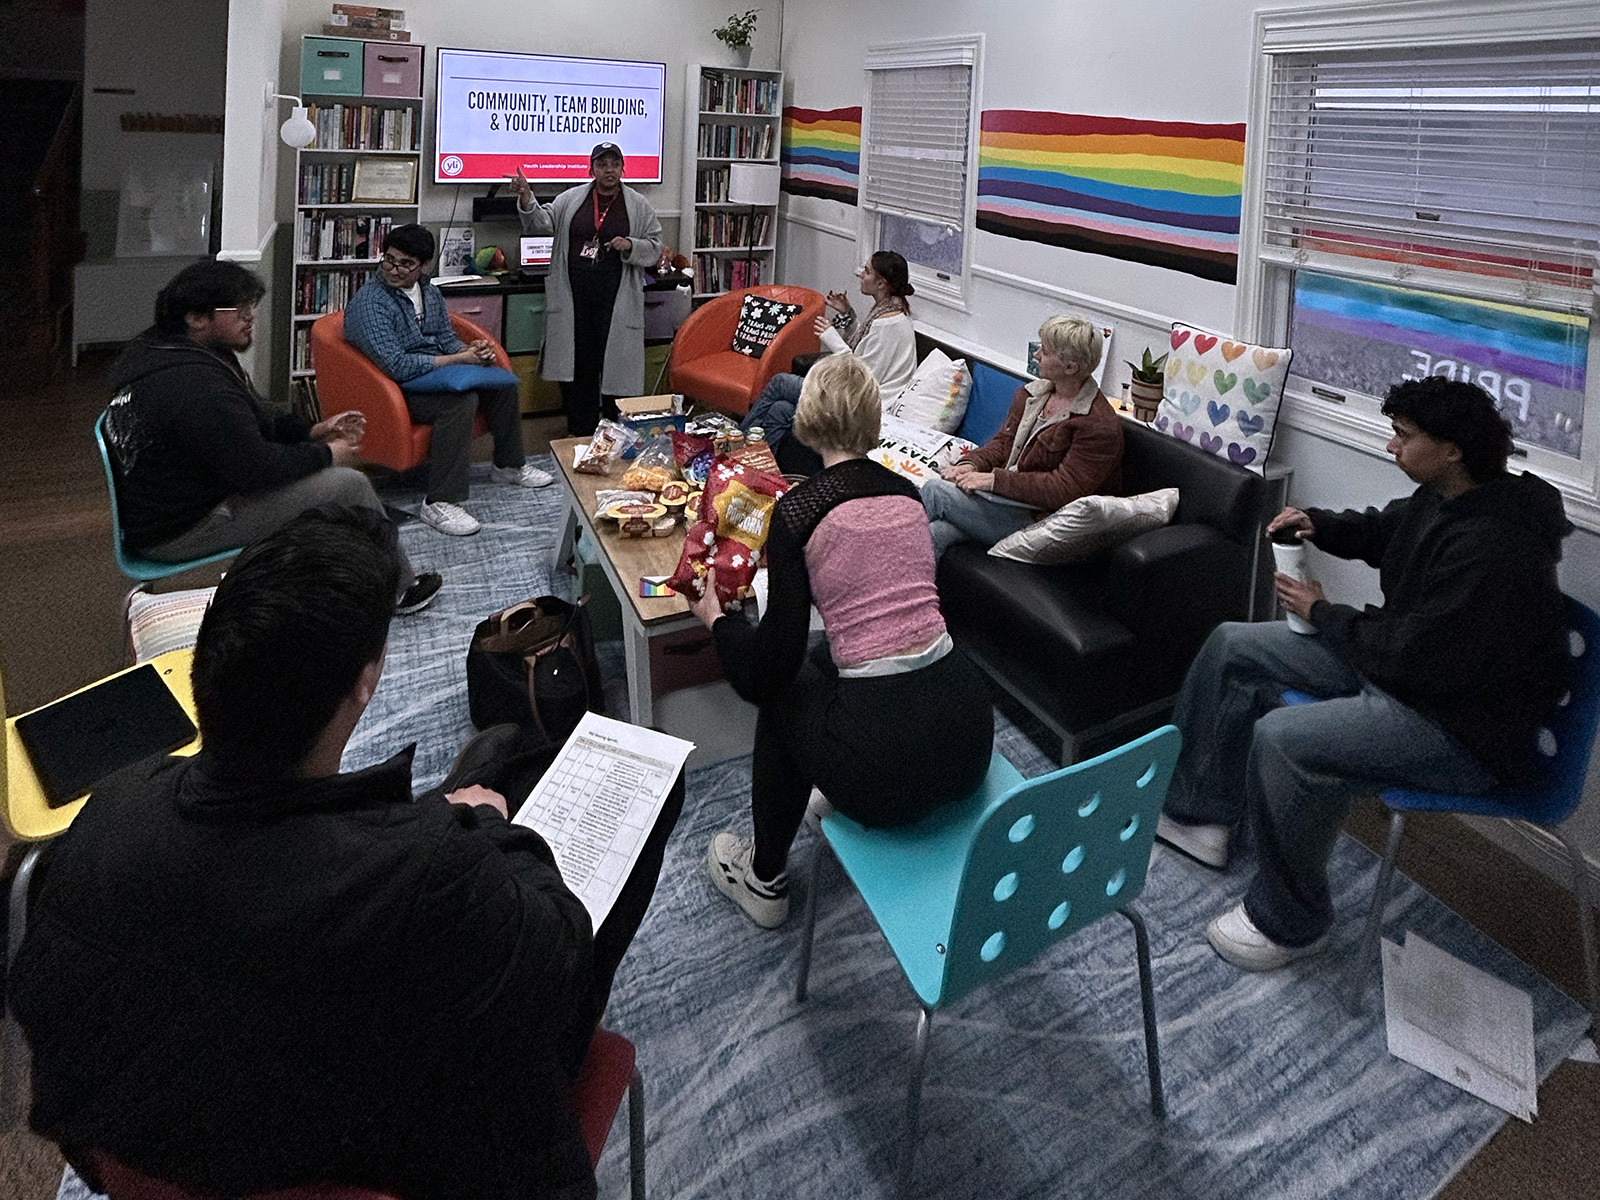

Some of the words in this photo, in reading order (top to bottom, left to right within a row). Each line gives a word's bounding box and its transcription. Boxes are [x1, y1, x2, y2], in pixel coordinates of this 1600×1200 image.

[467, 91, 550, 114] COMMUNITY,
[554, 95, 587, 114] TEAM
[591, 97, 648, 119] BUILDING,
[490, 113, 500, 131] &
[504, 114, 545, 132] YOUTH
[549, 115, 622, 134] LEADERSHIP
[446, 160, 459, 171] yli
